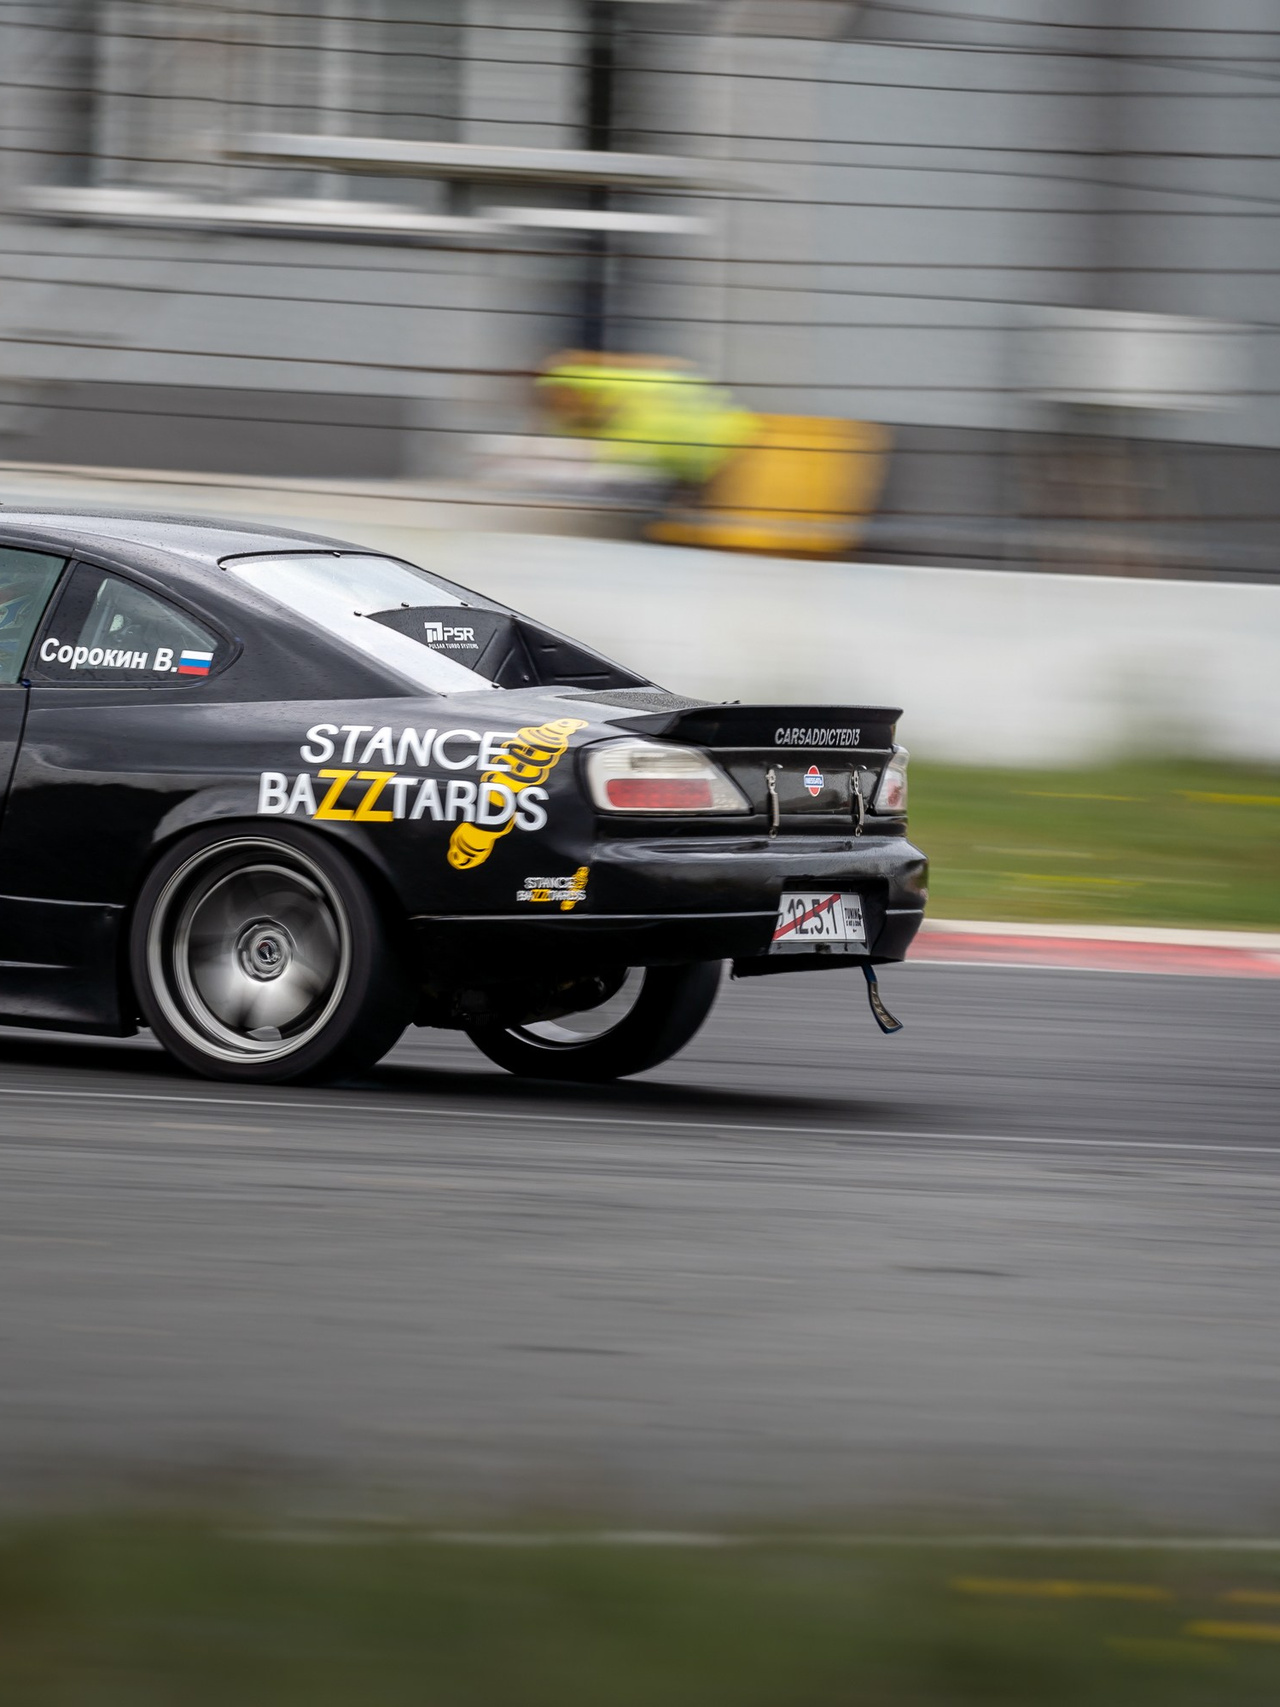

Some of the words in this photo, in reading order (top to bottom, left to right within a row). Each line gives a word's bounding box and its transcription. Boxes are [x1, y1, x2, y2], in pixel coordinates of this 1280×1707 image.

[443, 627, 474, 641] PSR
[39, 637, 149, 670] Сорокин
[153, 647, 178, 672] В.
[300, 724, 518, 772] STANCE
[774, 728, 861, 746] CARSADDICTED13
[257, 769, 549, 831] BAZZTARDS
[787, 898, 837, 935] 12.5.1
